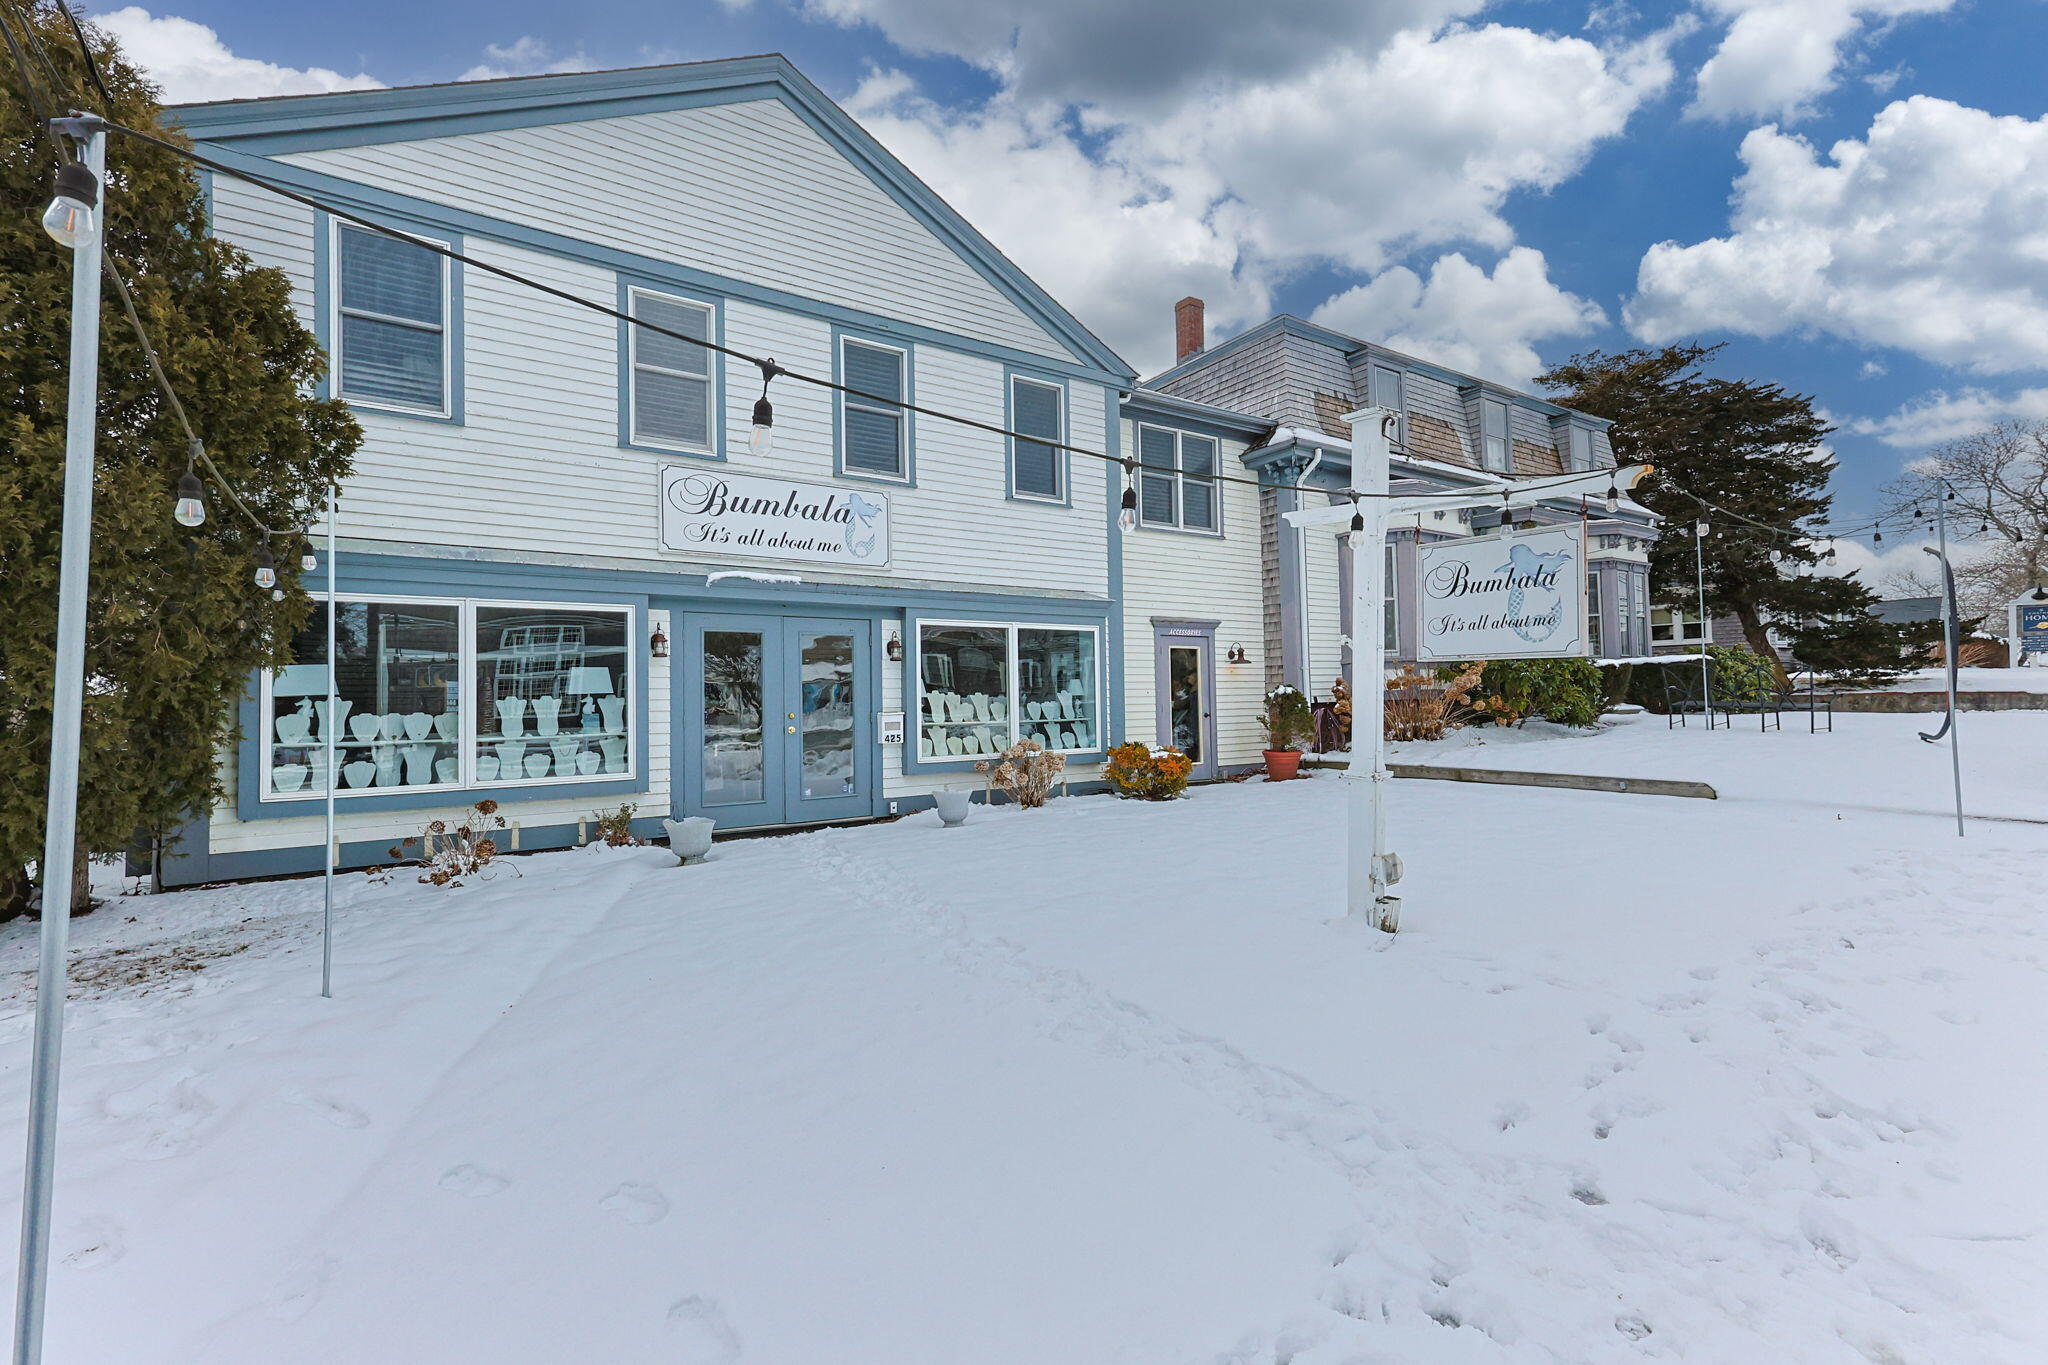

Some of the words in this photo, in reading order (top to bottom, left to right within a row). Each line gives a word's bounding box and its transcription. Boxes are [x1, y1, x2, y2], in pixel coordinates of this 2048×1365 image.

[668, 474, 853, 524] Bumbala
[684, 521, 731, 543] It's
[737, 529, 765, 546] all
[768, 531, 815, 550] about
[816, 542, 842, 553] me
[1425, 560, 1559, 599] Bumbala
[1168, 628, 1202, 636] ACCESSORIES
[1428, 614, 1464, 636] It's
[1468, 615, 1489, 631] all
[1491, 614, 1531, 630] about
[1532, 615, 1557, 627] me
[884, 734, 902, 743] 425
